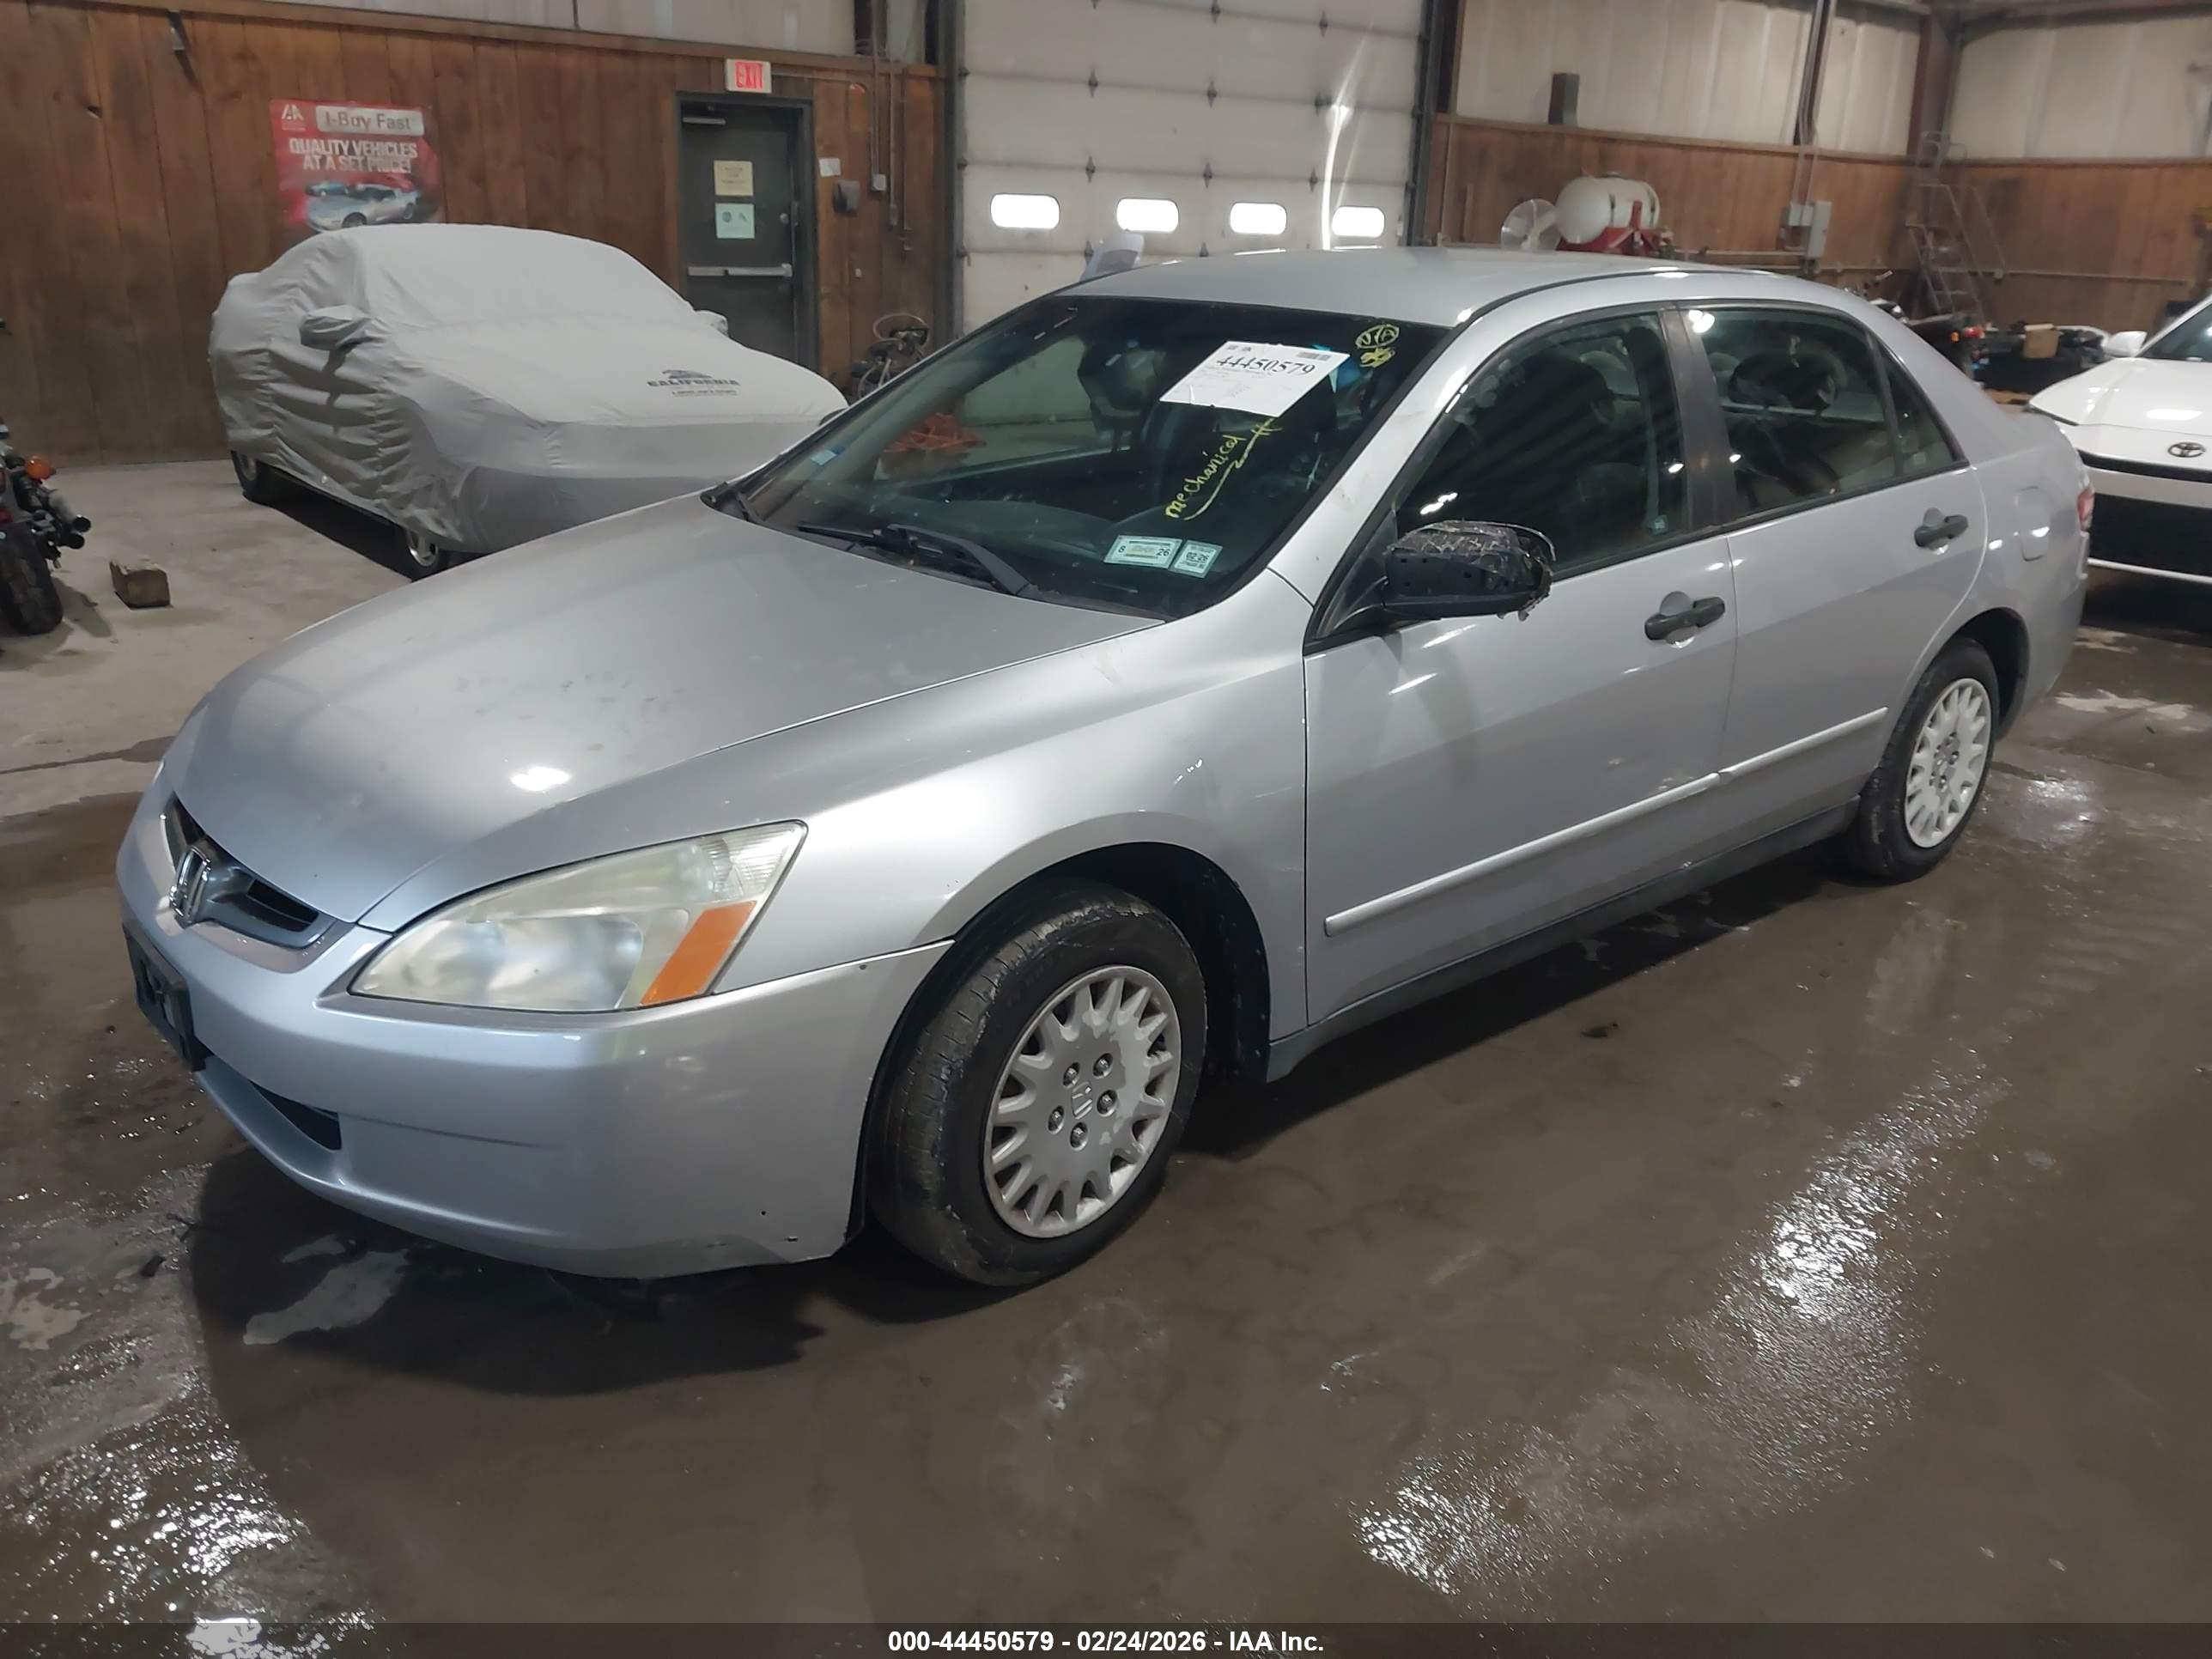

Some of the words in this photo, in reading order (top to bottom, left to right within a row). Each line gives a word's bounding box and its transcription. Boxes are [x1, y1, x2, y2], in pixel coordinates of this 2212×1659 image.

[735, 62, 763, 88] EXIT
[325, 110, 372, 130] I-Buy
[377, 113, 411, 131] Fast
[289, 137, 349, 155] QUALITY
[351, 140, 418, 158] VEHICLES
[303, 155, 323, 170] AT
[325, 155, 337, 171] A
[338, 155, 366, 172] SET
[1216, 355, 1316, 376] 44450579
[1156, 547, 1171, 558] 26
